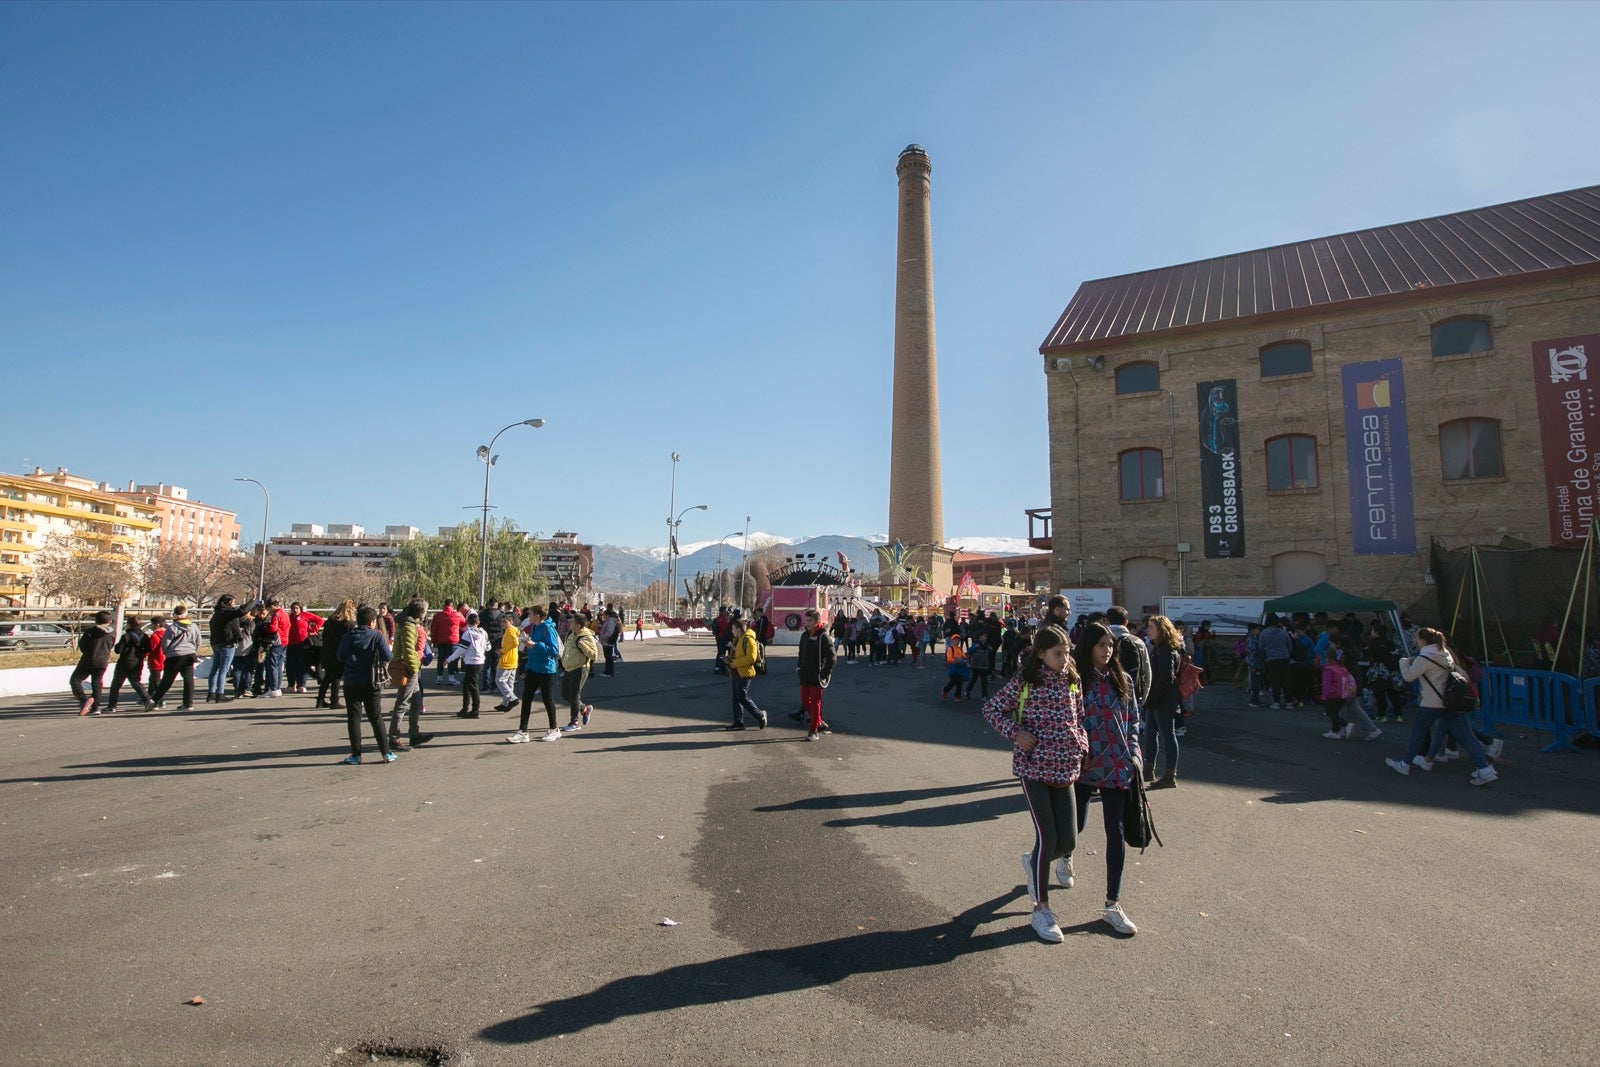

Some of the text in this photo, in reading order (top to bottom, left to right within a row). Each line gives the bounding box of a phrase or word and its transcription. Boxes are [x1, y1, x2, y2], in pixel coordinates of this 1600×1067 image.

[1383, 414, 1391, 452] GRANADA
[1561, 388, 1588, 463] Granada
[1222, 452, 1238, 533] CROSSBACK
[1570, 468, 1591, 490] de
[1209, 505, 1222, 533] DS 3
[1391, 514, 1397, 523] DE
[1556, 485, 1574, 540] Gran Hotel
